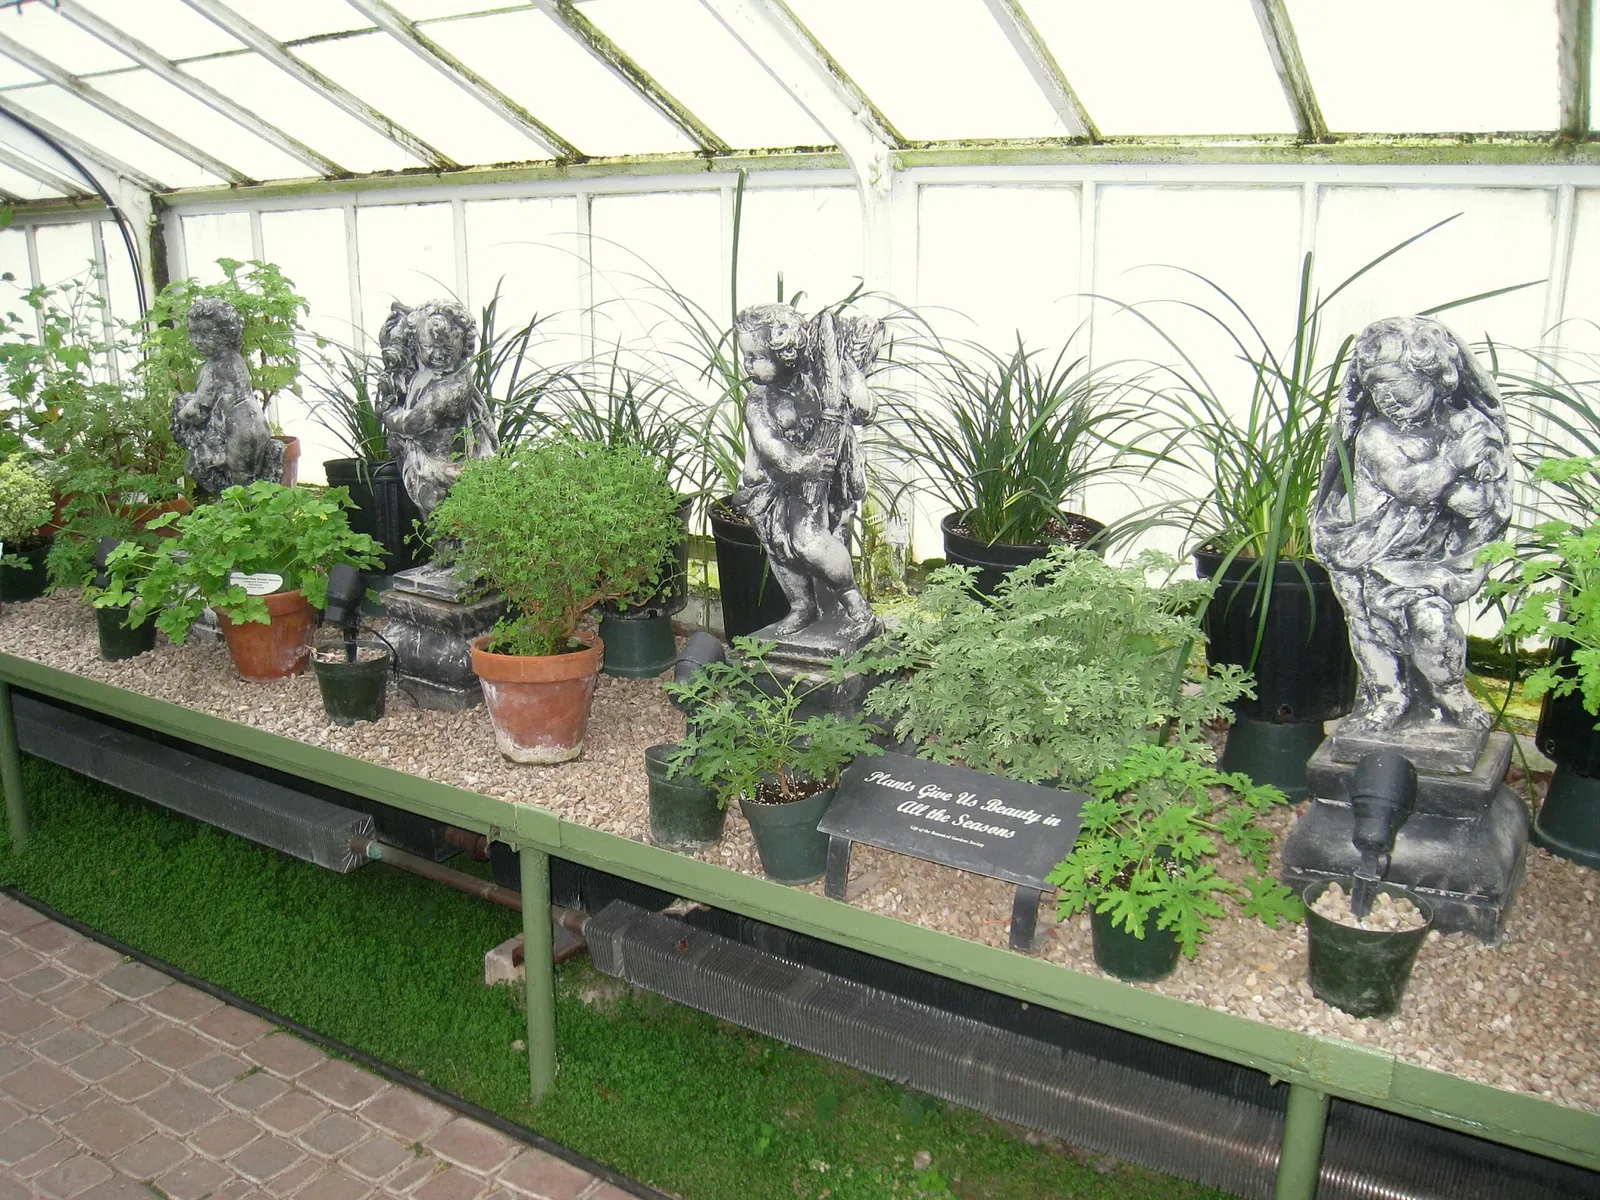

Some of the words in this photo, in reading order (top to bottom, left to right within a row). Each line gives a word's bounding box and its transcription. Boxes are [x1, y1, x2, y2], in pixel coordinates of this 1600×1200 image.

[864, 771, 916, 792] Plants
[917, 784, 953, 801] Give
[956, 791, 978, 807] Us
[980, 798, 1042, 825] Beauty
[1042, 813, 1062, 827] in
[896, 801, 930, 816] All
[925, 808, 951, 823] the
[951, 813, 1016, 838] Seasons
